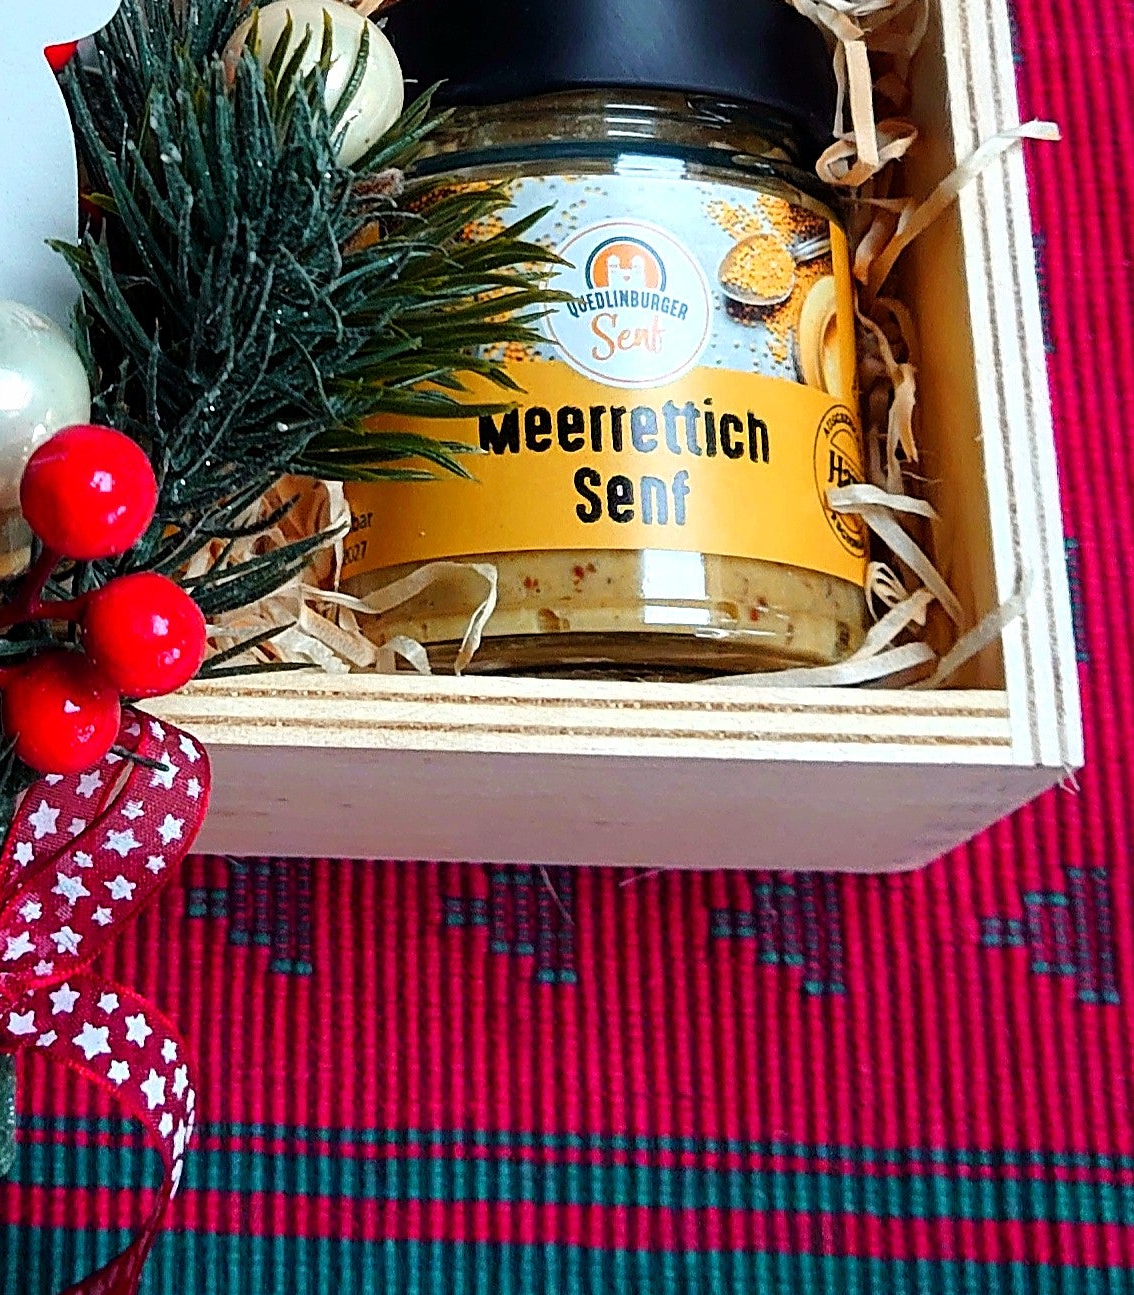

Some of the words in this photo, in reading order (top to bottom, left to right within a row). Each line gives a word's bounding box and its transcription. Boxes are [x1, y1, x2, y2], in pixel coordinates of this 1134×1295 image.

[591, 312, 666, 361] Senf
[478, 397, 770, 465] Meerrettich
[574, 466, 691, 526] Senf
